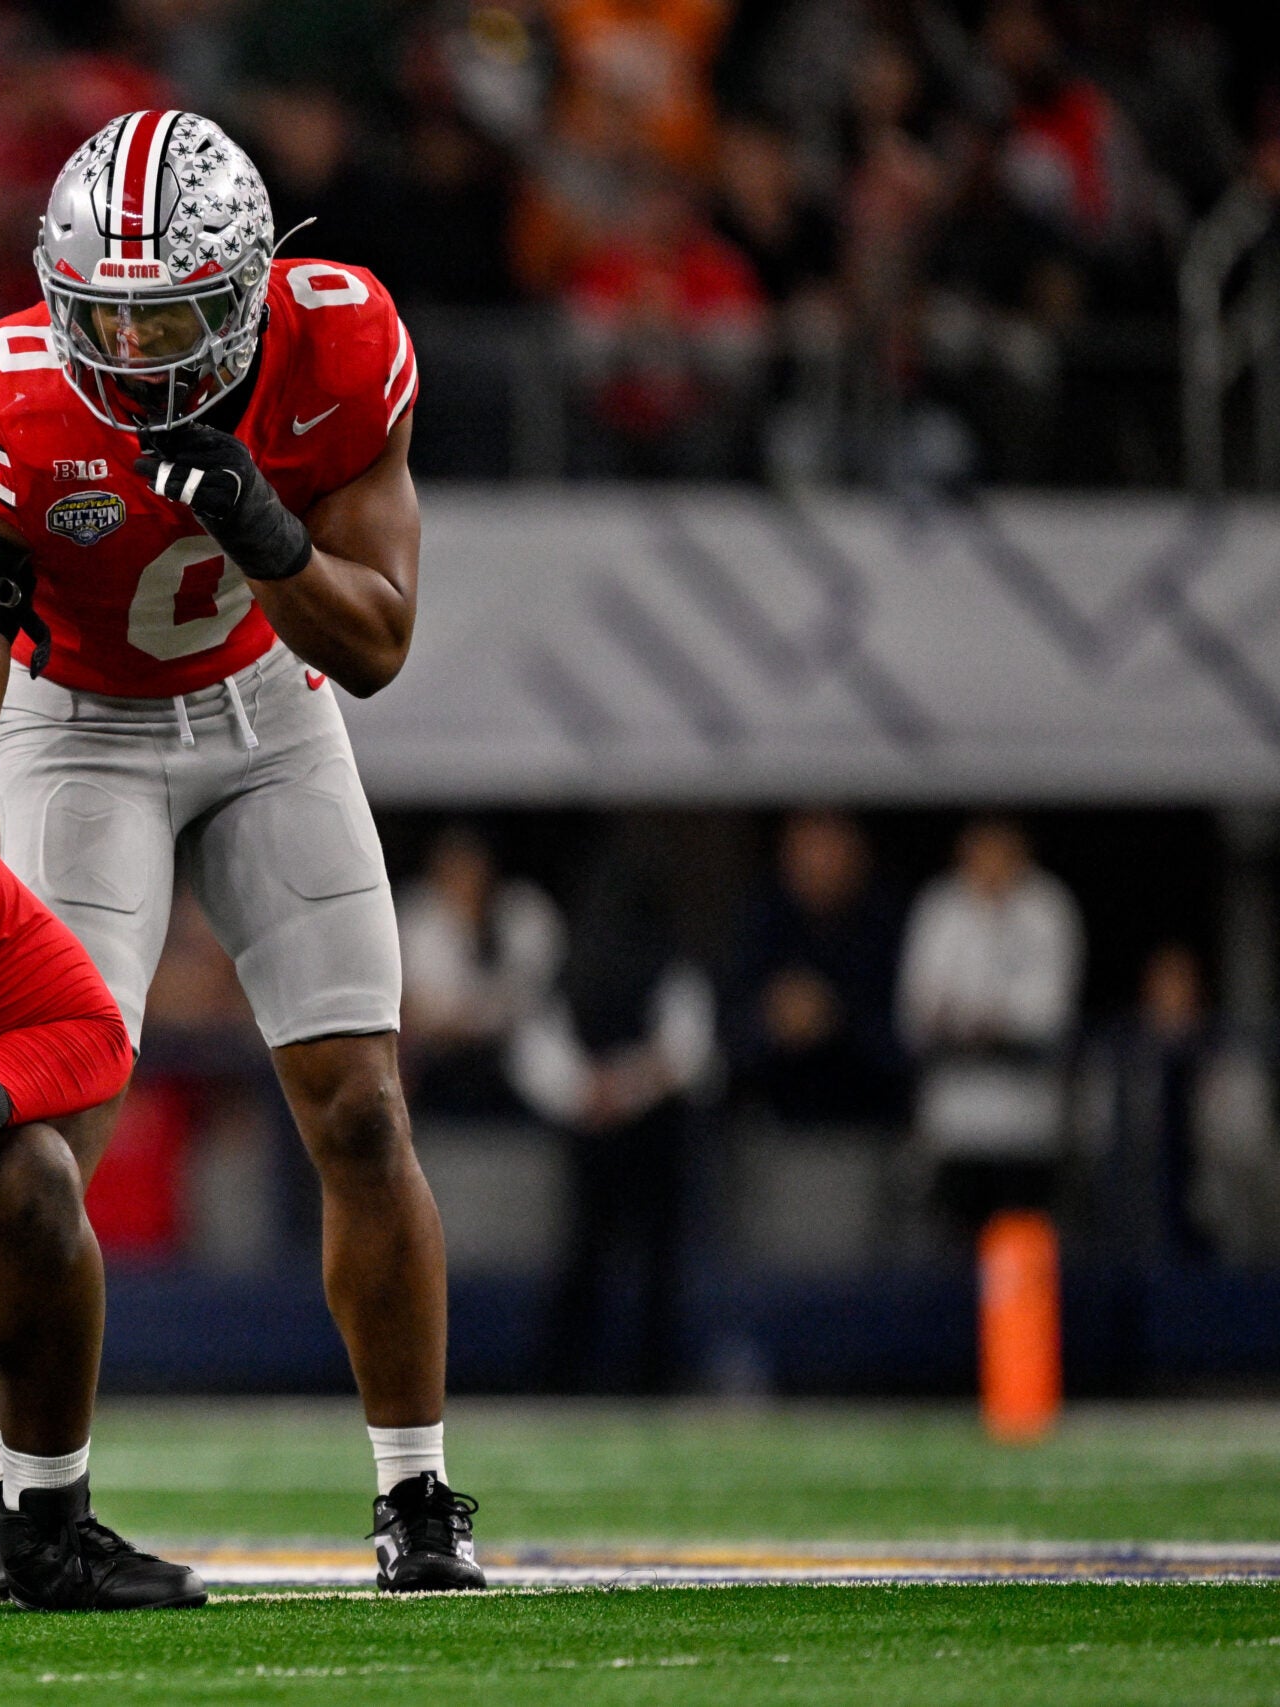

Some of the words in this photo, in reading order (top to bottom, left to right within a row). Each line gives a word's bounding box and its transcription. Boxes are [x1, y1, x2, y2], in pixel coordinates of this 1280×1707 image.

[99, 262, 125, 278] OHIO
[128, 263, 160, 278] STATE
[286, 263, 370, 311] 0
[53, 506, 119, 527] COTTON
[66, 518, 107, 530] BOWL
[127, 535, 257, 662] 0
